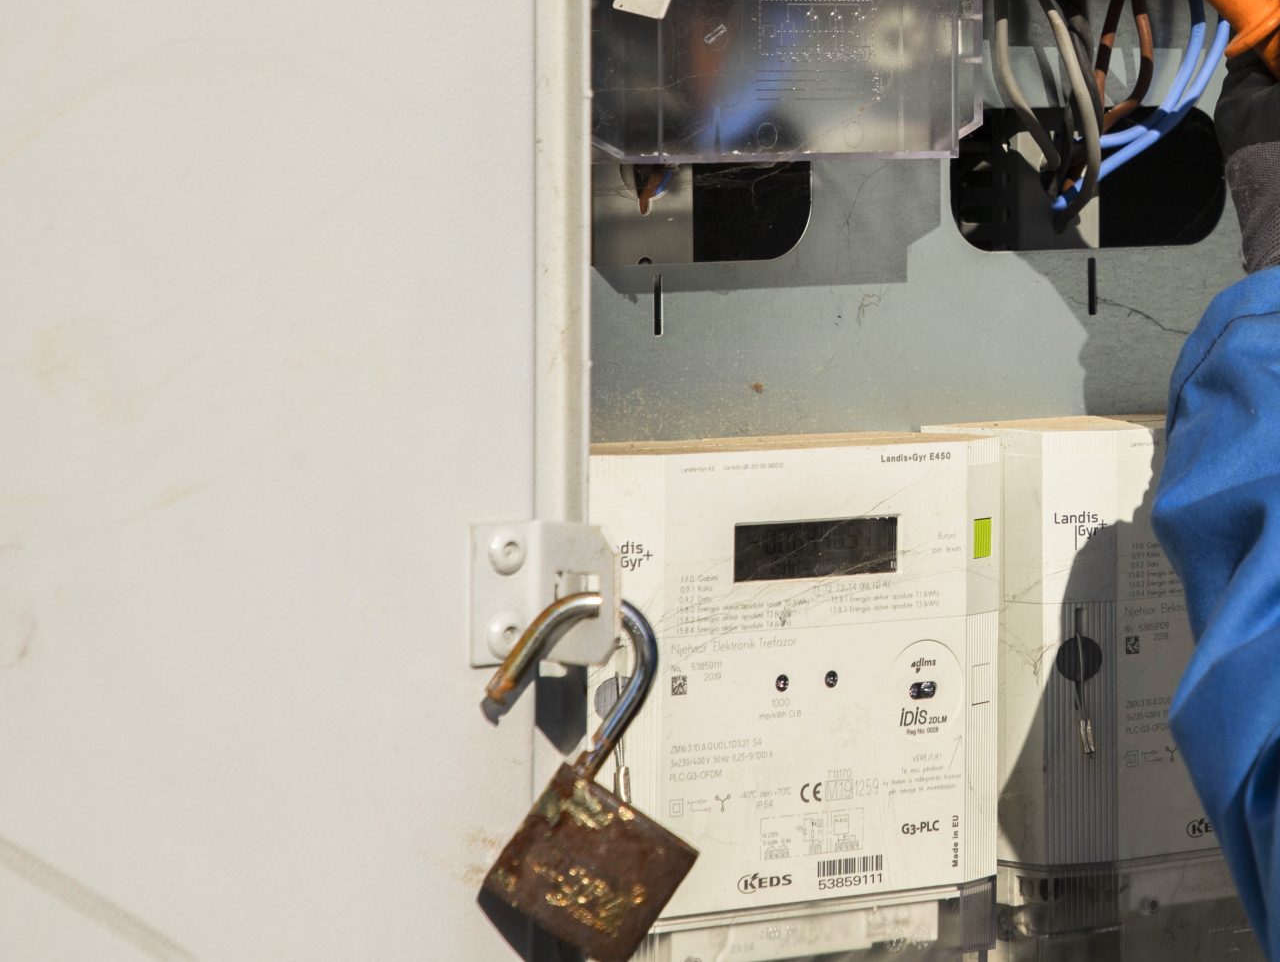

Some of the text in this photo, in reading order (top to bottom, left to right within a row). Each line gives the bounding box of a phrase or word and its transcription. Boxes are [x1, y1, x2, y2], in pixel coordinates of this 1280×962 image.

[929, 451, 951, 460] E450
[1054, 511, 1099, 525] Landis
[617, 541, 643, 555] dis
[712, 636, 755, 652] Elektronik
[758, 633, 796, 649] Trefazor
[703, 671, 722, 682] 2019
[771, 697, 790, 708] 1000
[928, 714, 947, 724] 2DLM
[905, 728, 916, 737] Reg
[826, 779, 852, 800] M19
[855, 777, 879, 797] 1259
[901, 819, 939, 836] G3-PLC
[1191, 818, 1214, 834] KE
[951, 813, 959, 868] Made in EU
[743, 868, 792, 891] KEDS
[817, 872, 883, 890] 53859111
